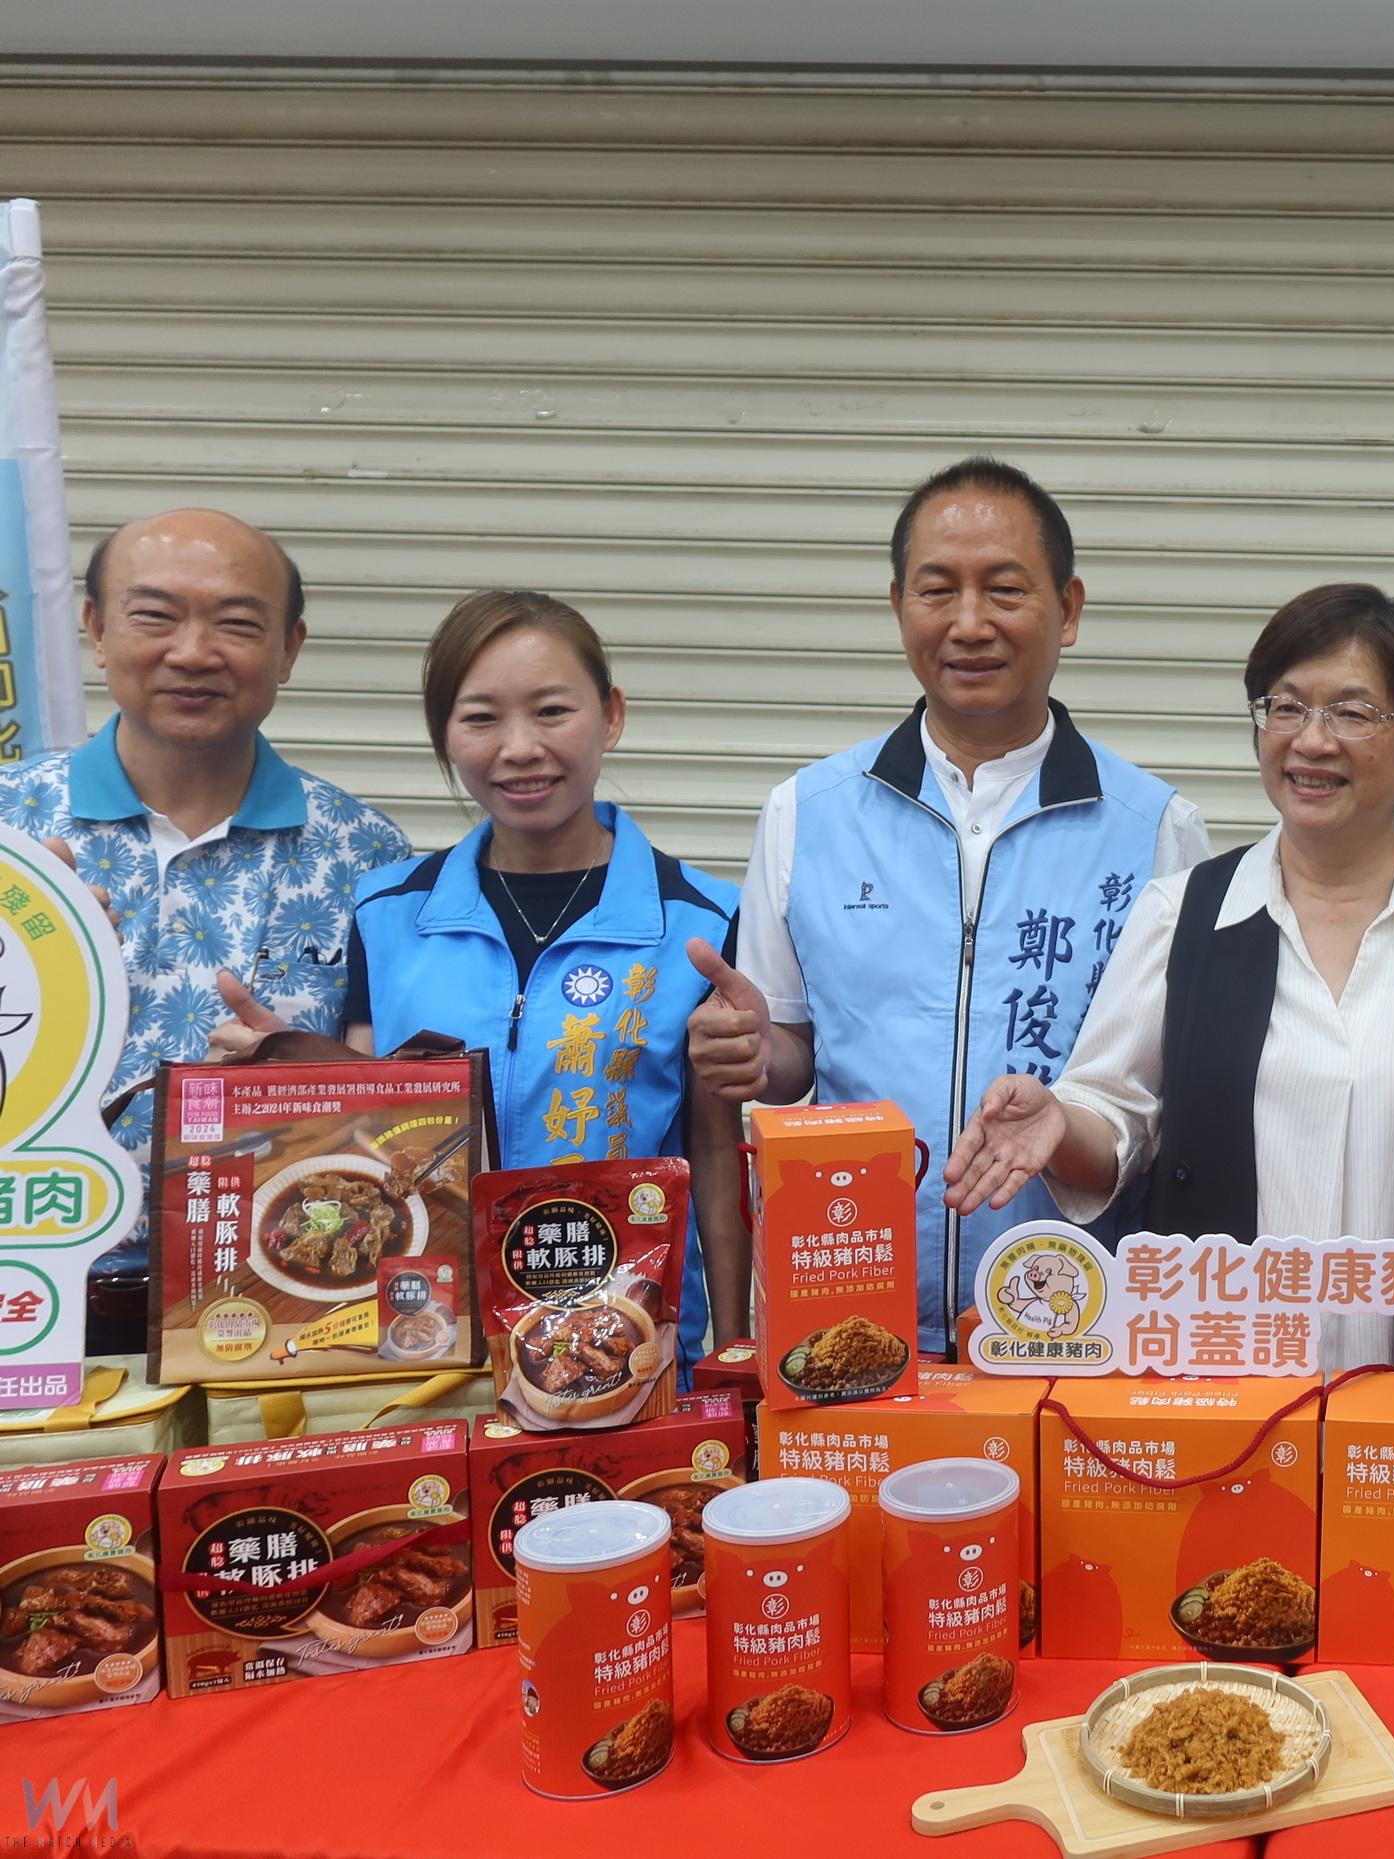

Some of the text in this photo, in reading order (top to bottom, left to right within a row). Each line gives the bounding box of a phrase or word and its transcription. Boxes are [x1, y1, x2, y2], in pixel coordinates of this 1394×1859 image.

[603, 963, 659, 1161] 彰化縣議員
[231, 1085, 262, 1098] 本產品
[543, 1012, 606, 1166] 蕭妤
[189, 1125, 216, 1134] 2024
[186, 1171, 212, 1225] 藥膳
[213, 1193, 241, 1274] 軟豚排
[537, 1220, 591, 1246] 藥膳
[791, 1227, 893, 1248] 彰化縣肉品市場
[526, 1244, 607, 1270] 軟豚排
[791, 1243, 895, 1270] 特級豬肉鬆
[792, 1265, 895, 1285] Fried Pork Fiber
[1023, 1311, 1042, 1324] Health
[990, 1340, 1102, 1359] 彰化健康豬肉
[1125, 1310, 1311, 1368] 尚蓋讚
[778, 1430, 889, 1450] 彰化縣肉品市場
[778, 1448, 890, 1473] 特級豬肉鬆
[1064, 1480, 1099, 1494] Fried
[1104, 1482, 1136, 1495] Pork
[1346, 1486, 1381, 1500] Fried
[227, 1531, 298, 1564] 藥膳
[928, 1583, 1007, 1610] 彰化縣肉品市場
[733, 1613, 820, 1635] 彰化縣肉品市場
[928, 1599, 1007, 1629] 特級豬肉鬆
[928, 1614, 1007, 1640] Fried Pork Fiber
[733, 1628, 821, 1655] 特級豬肉鬆
[733, 1647, 821, 1667] Fried Pork Fiber
[594, 1681, 625, 1697] Fried
[628, 1671, 651, 1688] Pork
